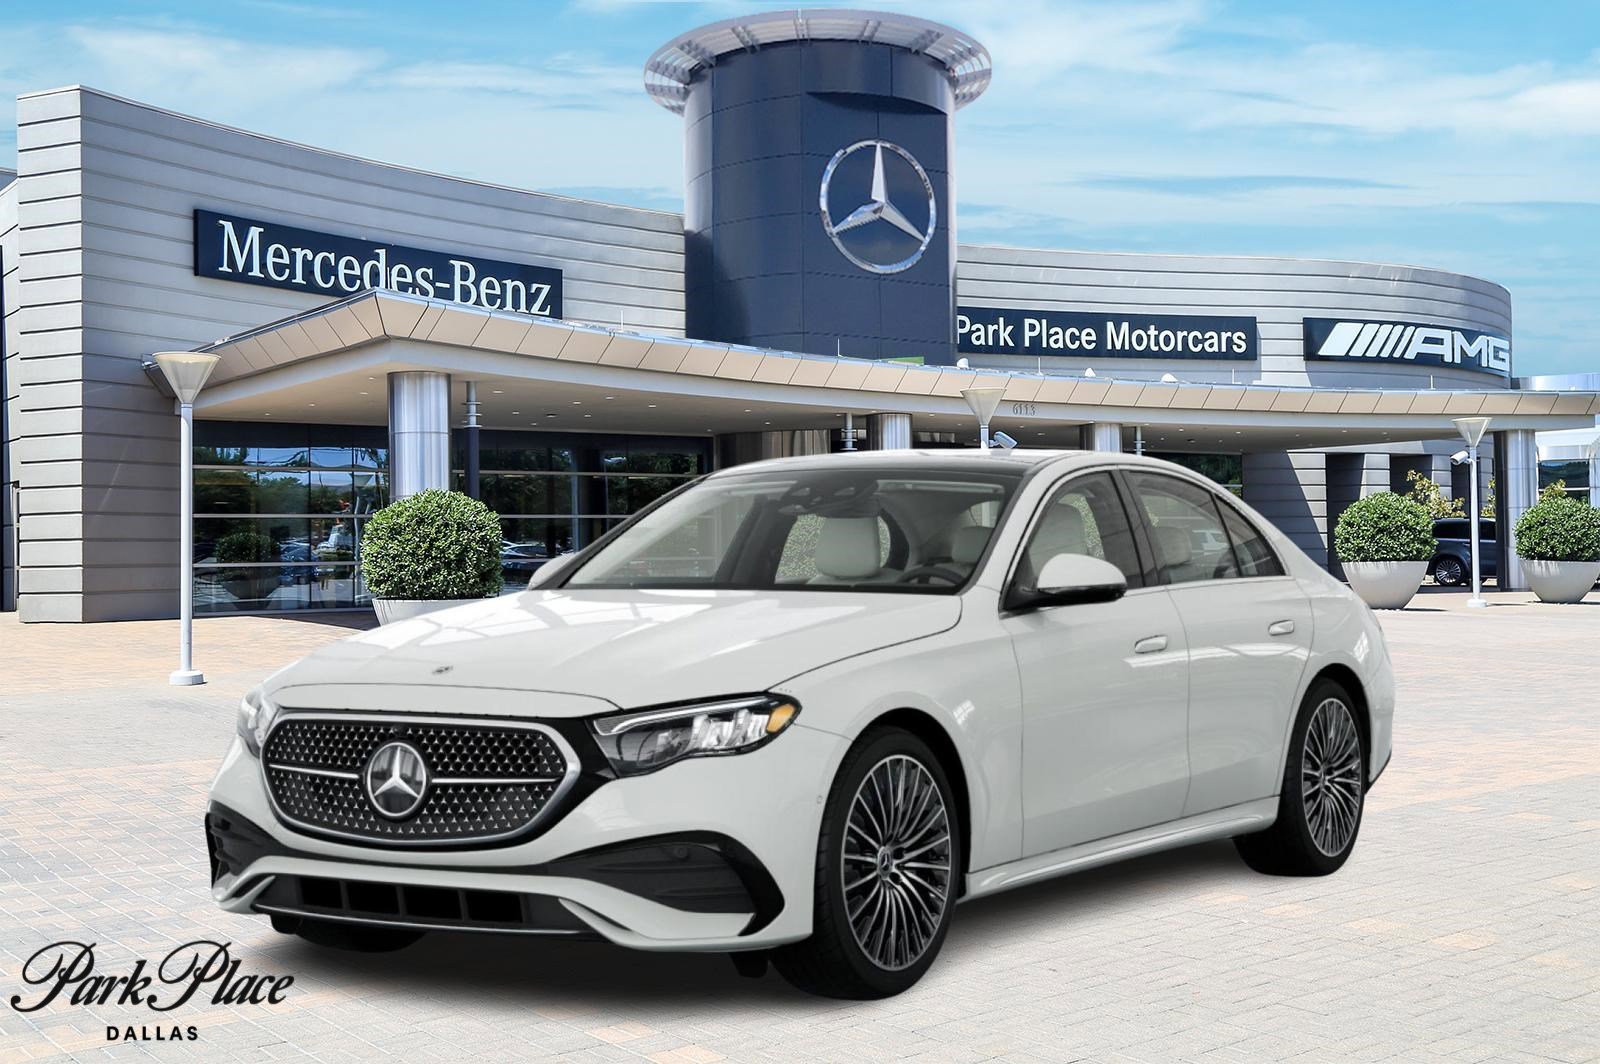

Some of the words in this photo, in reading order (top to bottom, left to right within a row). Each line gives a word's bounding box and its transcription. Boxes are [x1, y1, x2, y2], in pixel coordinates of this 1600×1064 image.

[218, 219, 552, 316] Mercedes-Benz
[957, 314, 1015, 347] Park
[1023, 318, 1097, 350] Place
[1106, 321, 1248, 354] Motorcars
[1404, 326, 1510, 373] AMG
